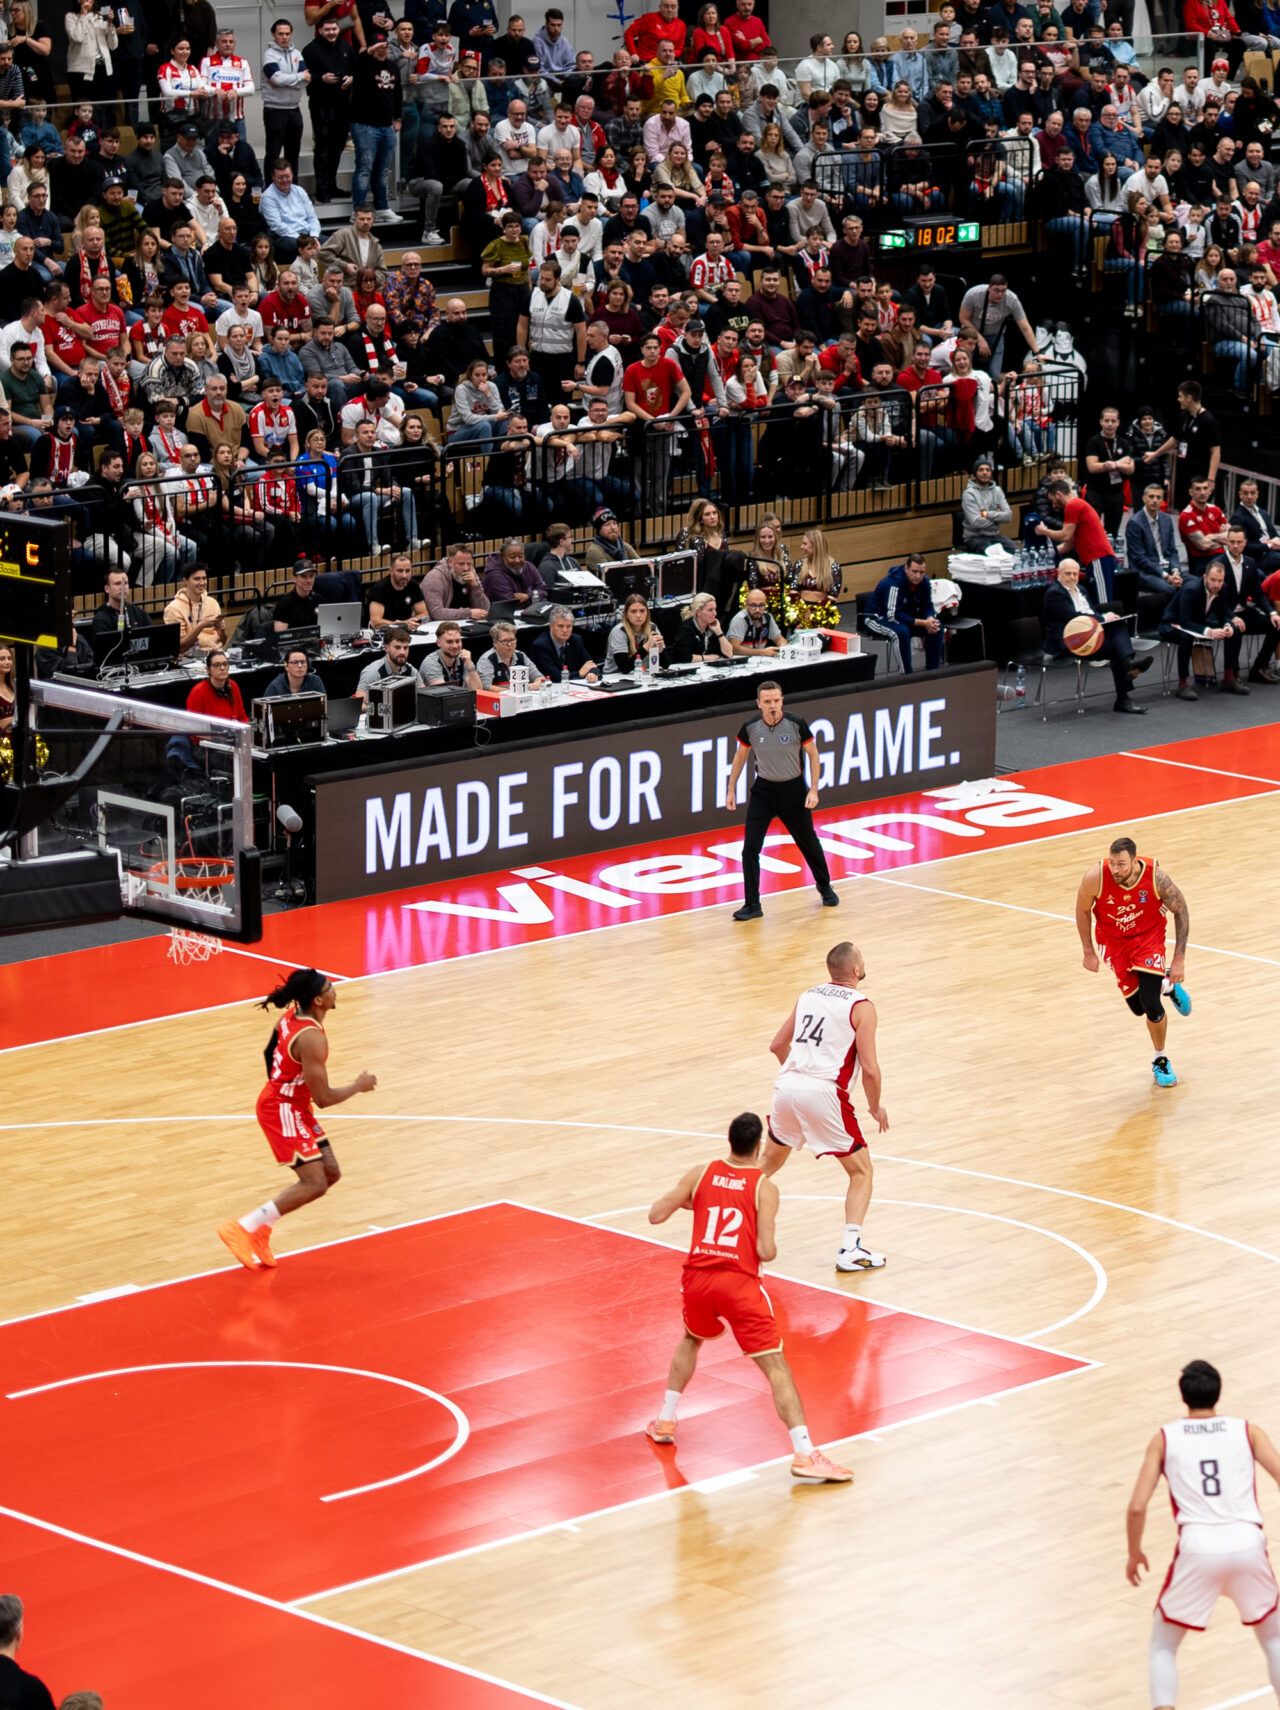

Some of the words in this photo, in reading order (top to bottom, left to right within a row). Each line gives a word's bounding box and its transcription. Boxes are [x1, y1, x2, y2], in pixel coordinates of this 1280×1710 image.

[366, 772, 528, 874] MADE
[553, 750, 662, 839] FOR
[683, 736, 758, 813] TH
[805, 698, 960, 791] GAME.
[402, 791, 1094, 924] vienna
[1117, 903, 1136, 915] 20
[796, 1014, 825, 1047] 24
[701, 1206, 744, 1247] 12
[1199, 1459, 1221, 1497] 8
